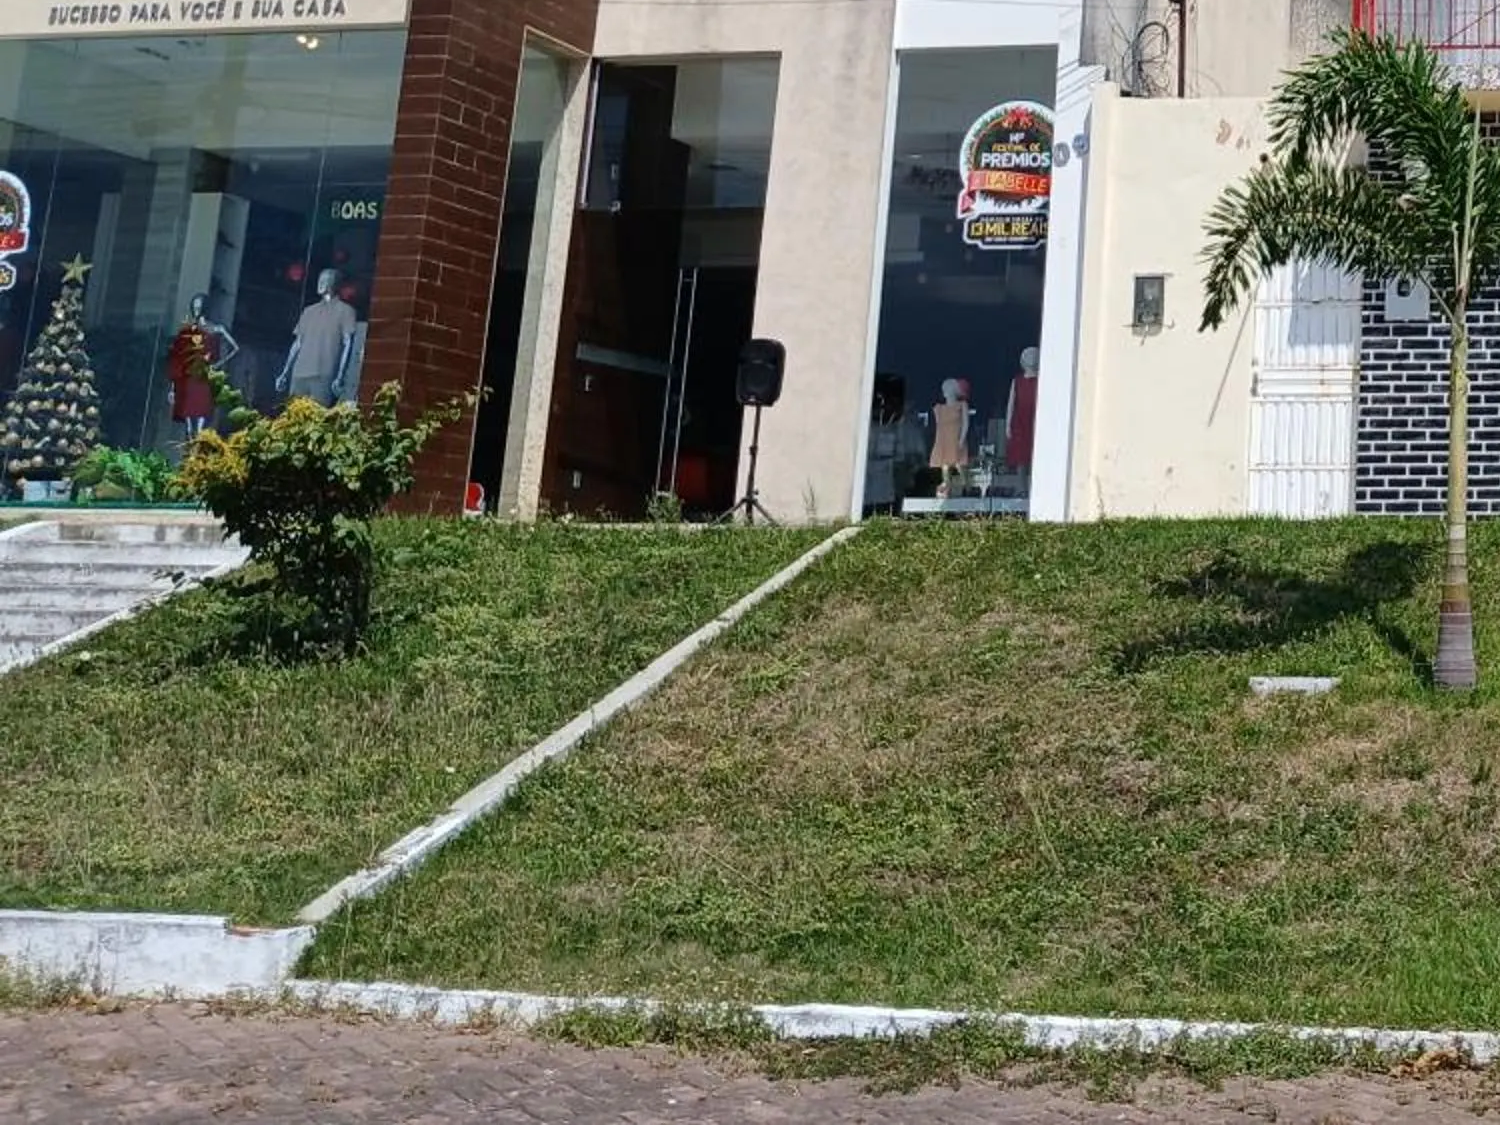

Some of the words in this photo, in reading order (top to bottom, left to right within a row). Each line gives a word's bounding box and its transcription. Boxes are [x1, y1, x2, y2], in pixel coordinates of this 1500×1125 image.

[48, 4, 122, 25] SUCESSO
[129, 2, 171, 23] PARA
[233, 0, 243, 20] E
[985, 172, 1049, 191] LABELLE
[331, 200, 378, 220] BOAS
